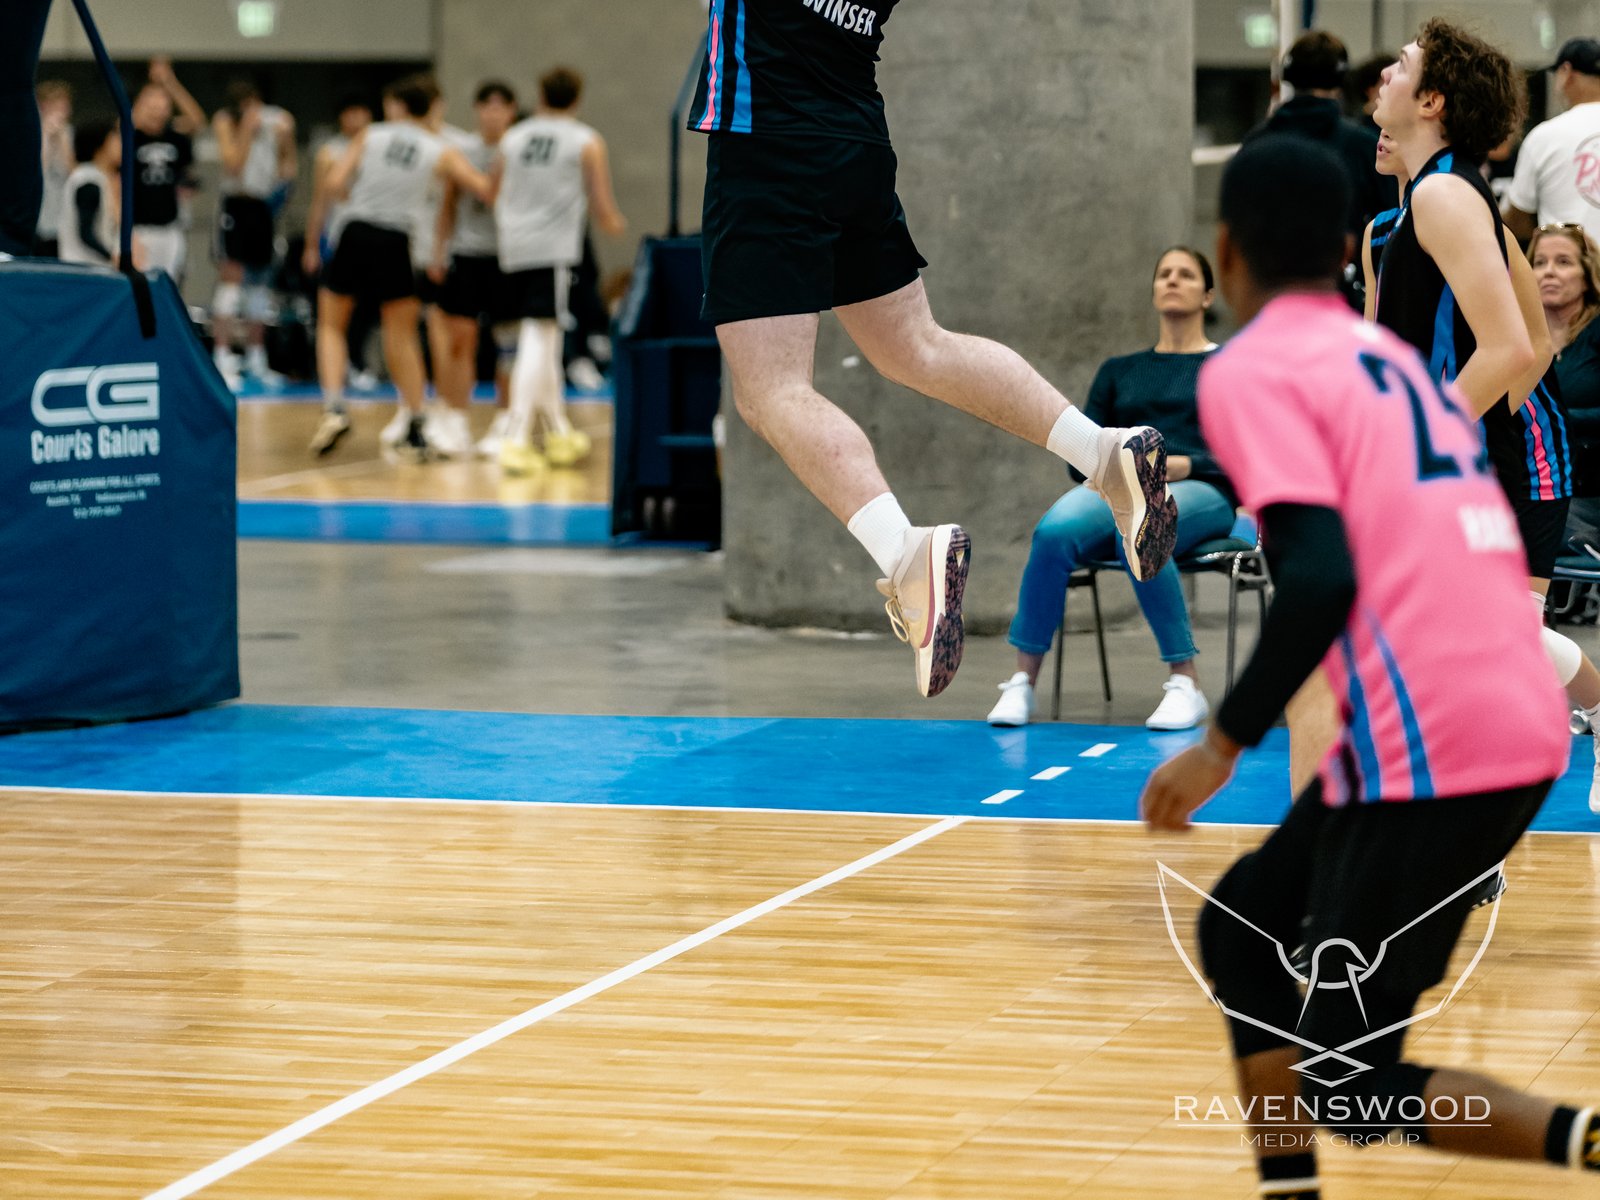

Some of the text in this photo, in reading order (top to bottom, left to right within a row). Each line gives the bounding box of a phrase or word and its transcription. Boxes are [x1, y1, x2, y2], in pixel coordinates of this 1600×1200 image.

[31, 362, 160, 427] CG
[31, 424, 160, 465] Courts Galore
